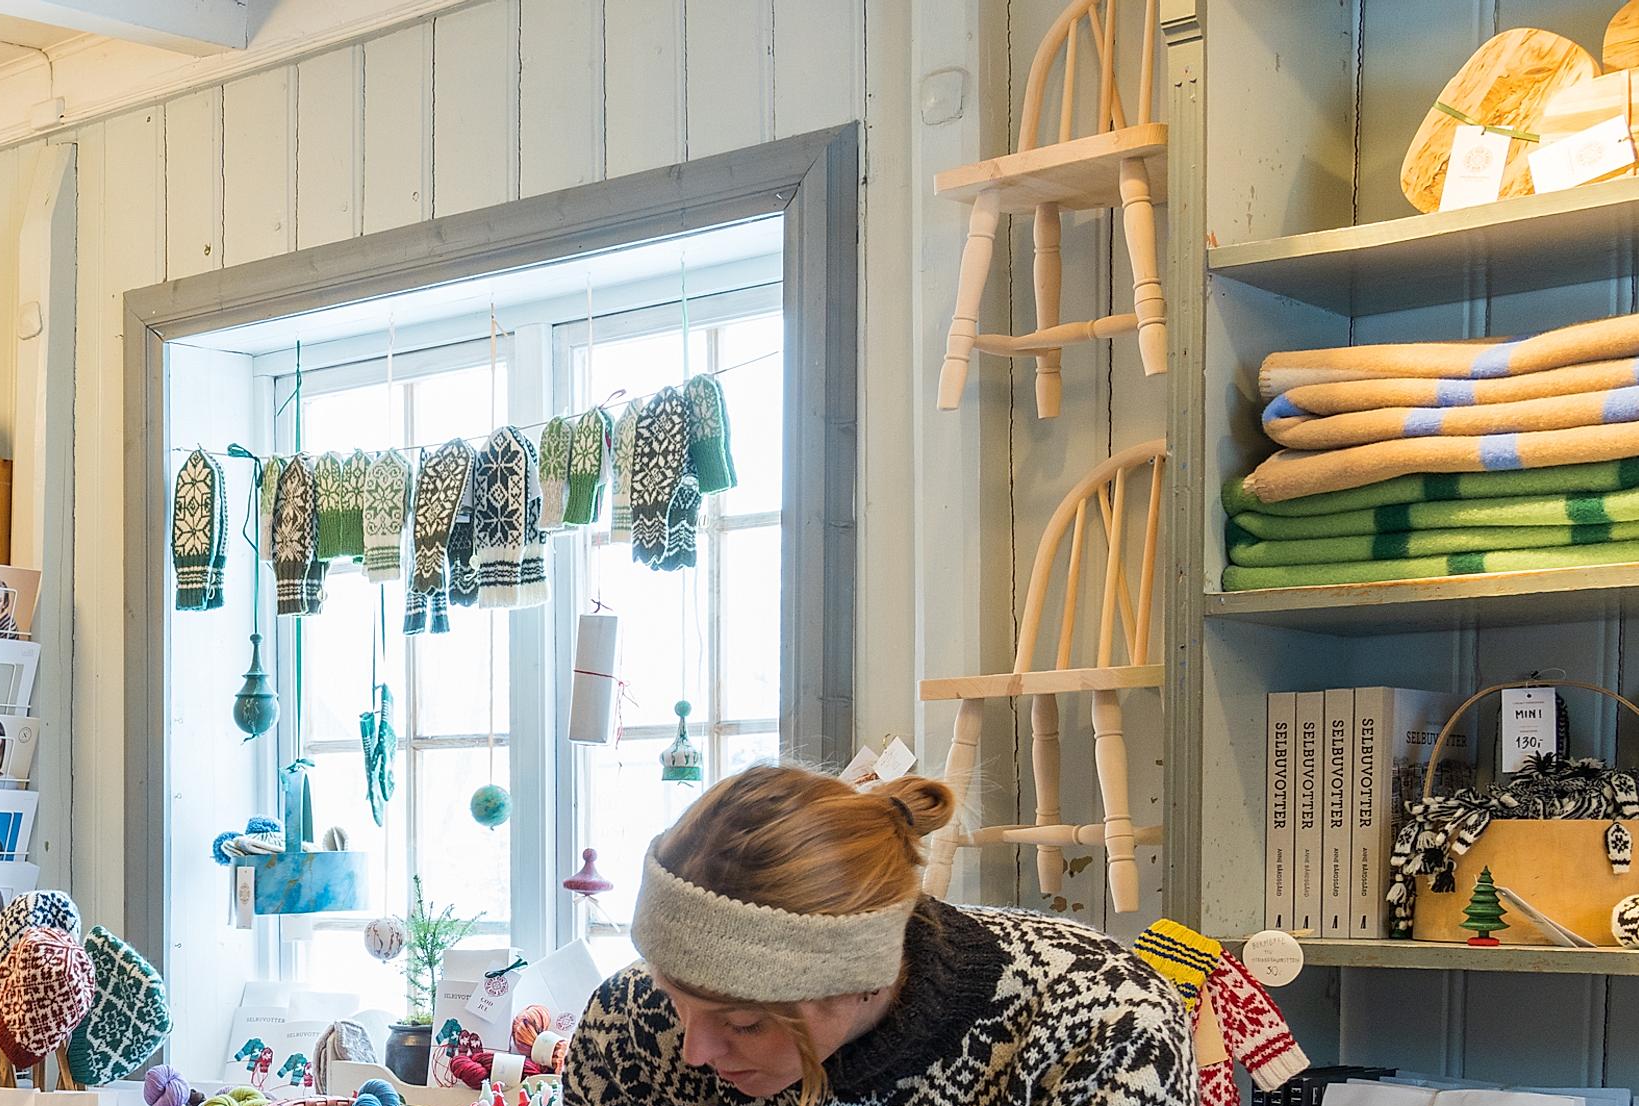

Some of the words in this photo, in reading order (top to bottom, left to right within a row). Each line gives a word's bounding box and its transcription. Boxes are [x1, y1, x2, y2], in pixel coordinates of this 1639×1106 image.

[1515, 708, 1542, 720] MINI
[1274, 721, 1288, 830] SELBUVOTTER
[1301, 721, 1315, 830] SELBUVOTTER
[1330, 719, 1345, 829] SELBUVOTTER
[1359, 717, 1374, 828] SELBUVOTTER
